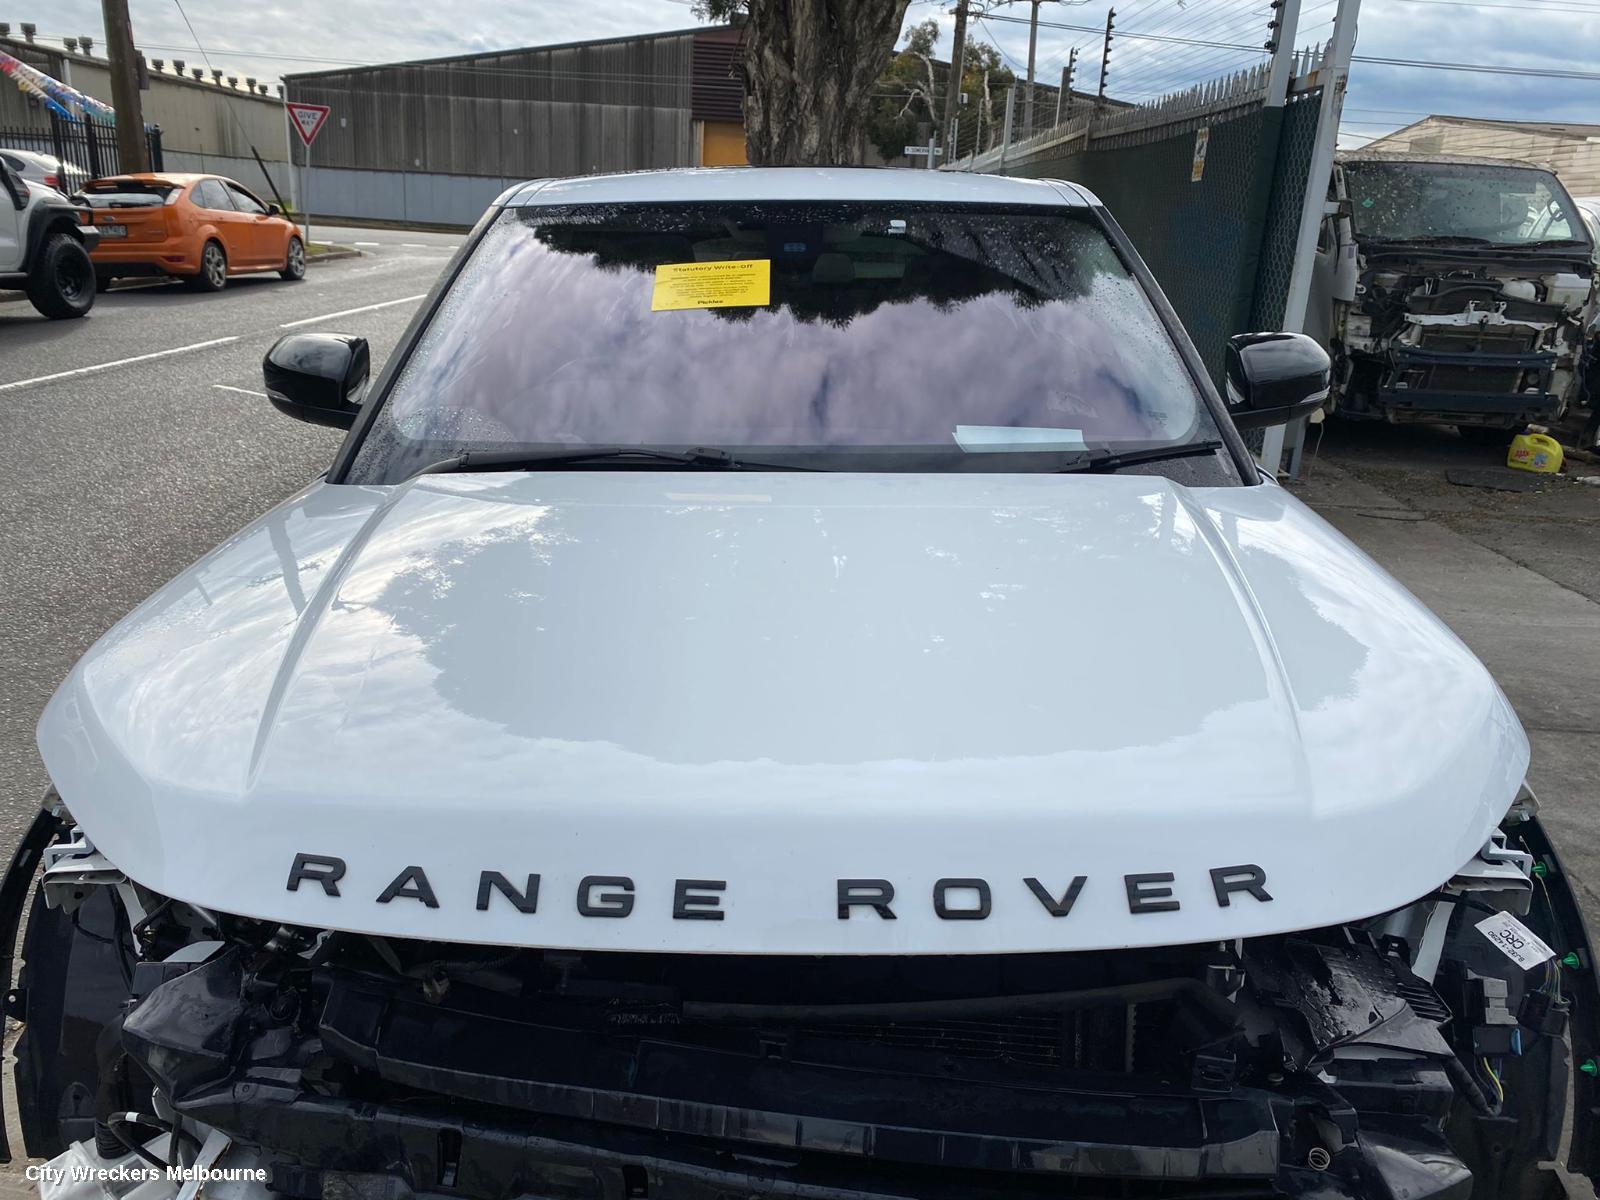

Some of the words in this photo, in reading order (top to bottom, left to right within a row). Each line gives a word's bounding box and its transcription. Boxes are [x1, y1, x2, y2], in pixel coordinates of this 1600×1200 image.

[298, 111, 318, 120] GIVE
[673, 265, 712, 273] Statutory
[286, 852, 727, 920] RANGE
[837, 863, 1274, 920] ROVER
[1499, 929, 1525, 950] CRC
